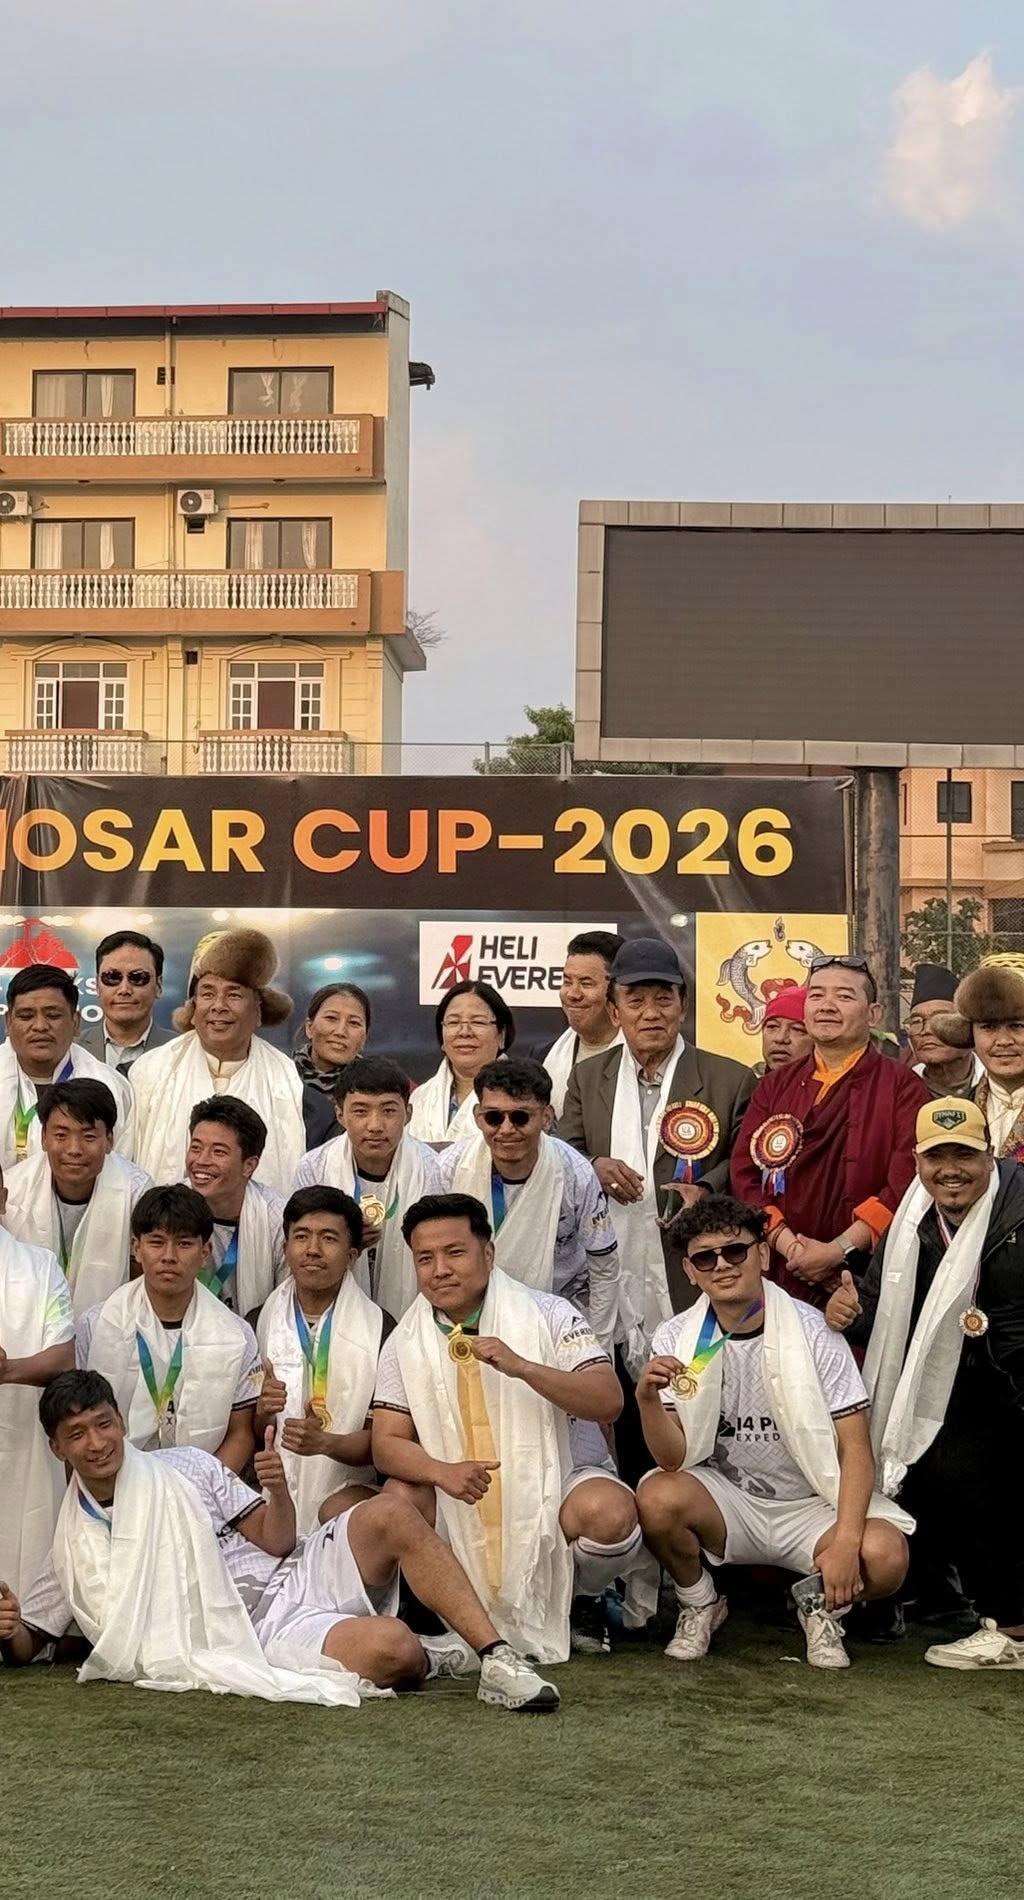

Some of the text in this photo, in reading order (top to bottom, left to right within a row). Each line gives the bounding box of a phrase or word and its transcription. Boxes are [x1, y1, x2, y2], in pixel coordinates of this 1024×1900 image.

[293, 807, 795, 878] CUP-2026
[479, 935, 538, 960] HELI
[478, 965, 564, 991] EVERE
[736, 1433, 780, 1442] EXPED
